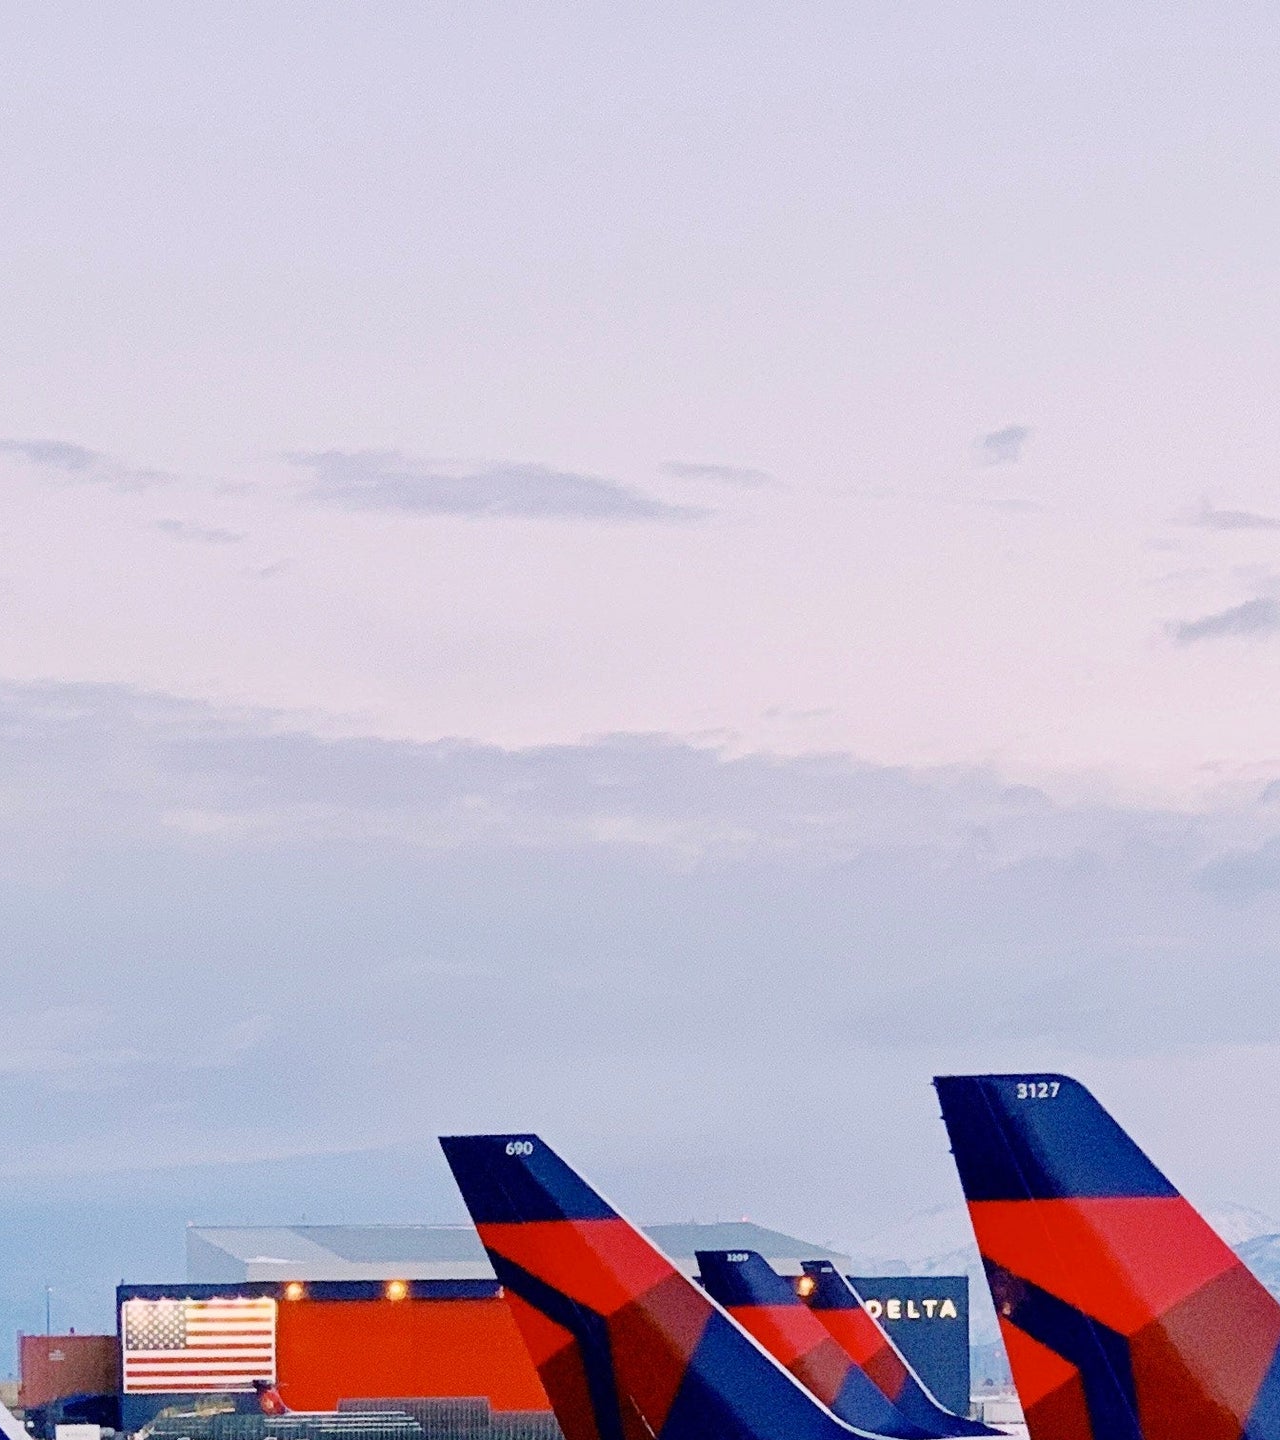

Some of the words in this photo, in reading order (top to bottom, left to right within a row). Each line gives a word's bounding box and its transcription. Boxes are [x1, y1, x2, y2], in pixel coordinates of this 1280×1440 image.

[1016, 1081, 1060, 1099] 3127
[505, 1141, 534, 1156] 690
[865, 1299, 958, 1319] DELTA
